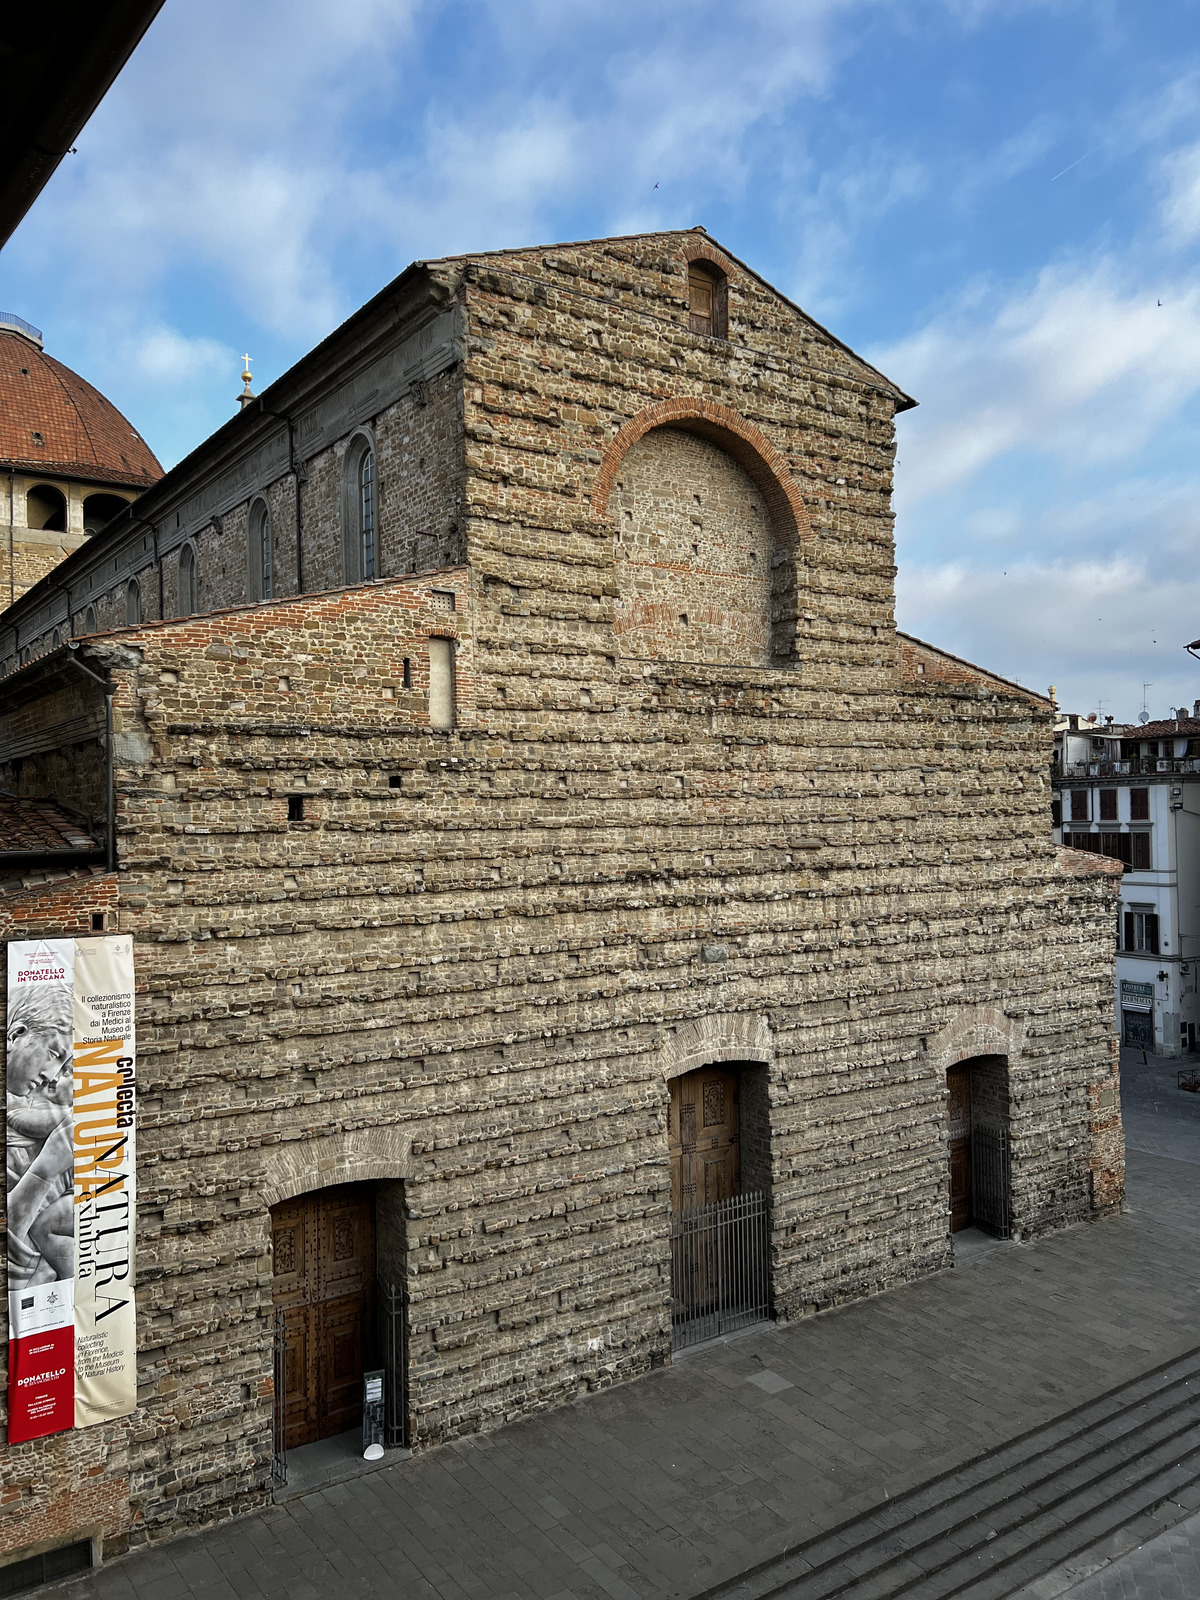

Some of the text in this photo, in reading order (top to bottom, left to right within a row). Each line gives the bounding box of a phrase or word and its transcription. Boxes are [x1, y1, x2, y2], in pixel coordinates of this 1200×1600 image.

[18, 968, 65, 976] DONATELLO
[28, 974, 65, 982] TOSCANA
[87, 993, 131, 1002] collezionismo
[1124, 996, 1151, 1004] FARMACIA
[92, 1001, 131, 1010] naturalistico
[108, 1008, 131, 1017] Firenze
[90, 1019, 100, 1027] dai
[102, 1017, 123, 1026] Medici
[102, 1026, 123, 1034] Museo
[82, 1033, 131, 1044] Storia Naturale
[116, 1057, 136, 1128] collecta
[73, 1040, 124, 1204] NATURA
[94, 1132, 130, 1326] NATURA
[79, 1191, 100, 1280] exhibita
[78, 1331, 108, 1344] Naturalistic
[78, 1340, 104, 1351] collecting
[84, 1346, 109, 1357] Florence,
[78, 1358, 91, 1366] from
[102, 1350, 124, 1360] Medicis
[95, 1359, 119, 1370] Museum
[85, 1368, 105, 1378] Natural
[106, 1364, 125, 1375] History
[18, 1368, 66, 1386] DONATELLO
